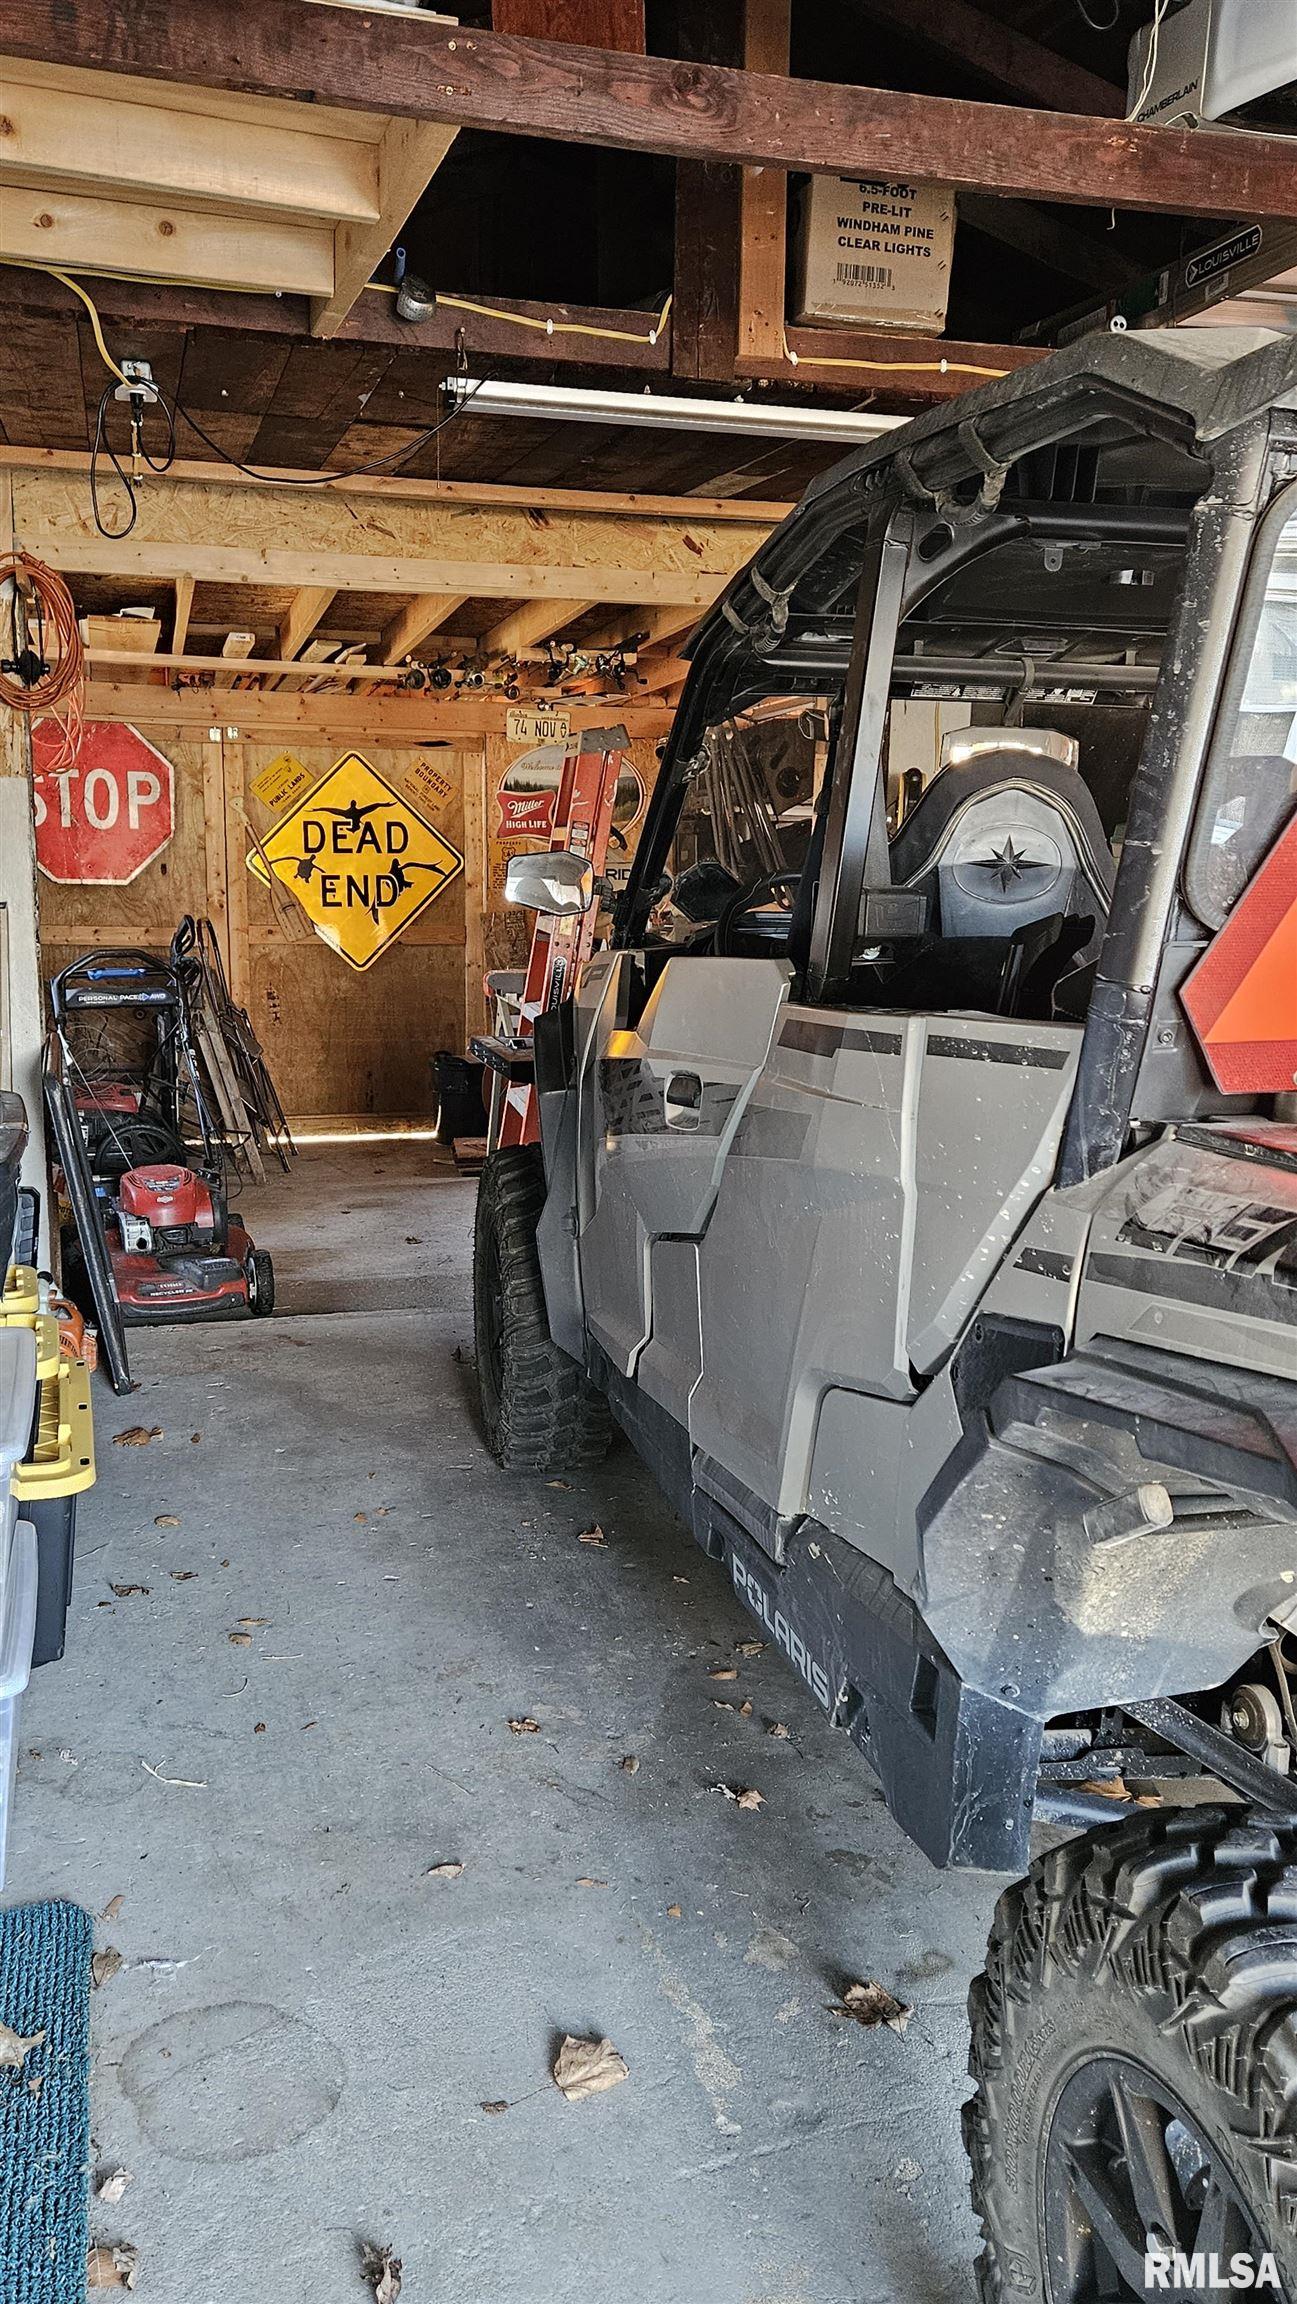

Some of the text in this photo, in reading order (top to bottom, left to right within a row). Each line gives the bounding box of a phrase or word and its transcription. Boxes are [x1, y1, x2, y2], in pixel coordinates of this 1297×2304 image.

[1137, 78, 1199, 122] CHAMBERLAIN
[859, 184, 917, 200] 6.5-FOOT
[862, 201, 912, 218] PRE-LIT
[837, 216, 934, 239] WINDHAM PINE
[837, 236, 931, 257] CLEAR LIGHTS
[1198, 233, 1260, 274] LOUISVILLE
[513, 718, 527, 736] 74
[534, 720, 556, 738] NOV
[269, 788, 288, 807] PUBLIC
[287, 772, 305, 790] LANDS
[414, 767, 448, 798] BOUNDARY
[420, 762, 452, 792] PROPERTY
[507, 799, 545, 817] Miller
[302, 820, 409, 854] DEAD
[506, 820, 547, 829] HIGH LIFE
[320, 874, 398, 907] END
[732, 1553, 830, 1713] POLARIS
